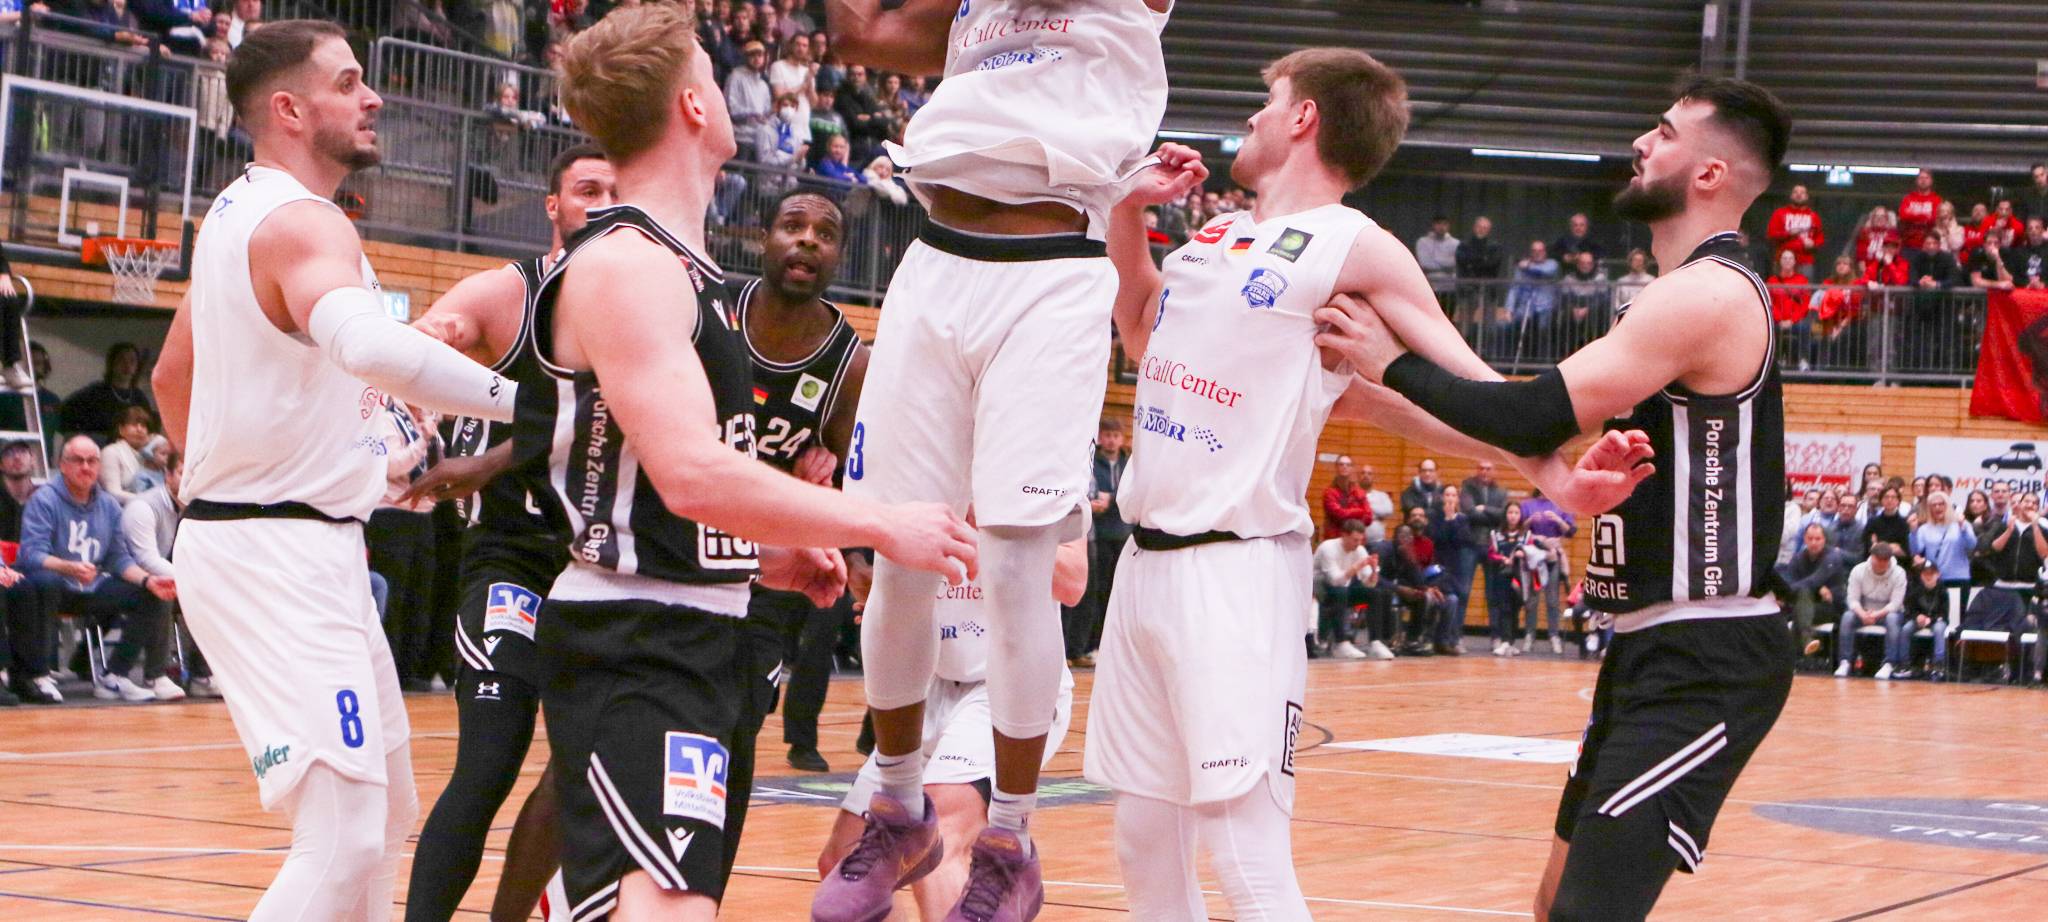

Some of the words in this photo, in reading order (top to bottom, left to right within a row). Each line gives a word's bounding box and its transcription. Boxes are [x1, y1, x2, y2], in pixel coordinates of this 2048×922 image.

[588, 387, 609, 458] orsche
[757, 416, 812, 459] 24
[1705, 418, 1724, 486] Porsche
[582, 460, 606, 517] Zentr
[1022, 485, 1060, 497] CRAFT
[1704, 488, 1723, 563] Zentrum
[936, 580, 984, 600] Cente
[1704, 565, 1723, 600] Gie
[336, 689, 364, 749] 8
[1202, 759, 1240, 769] CRAFT
